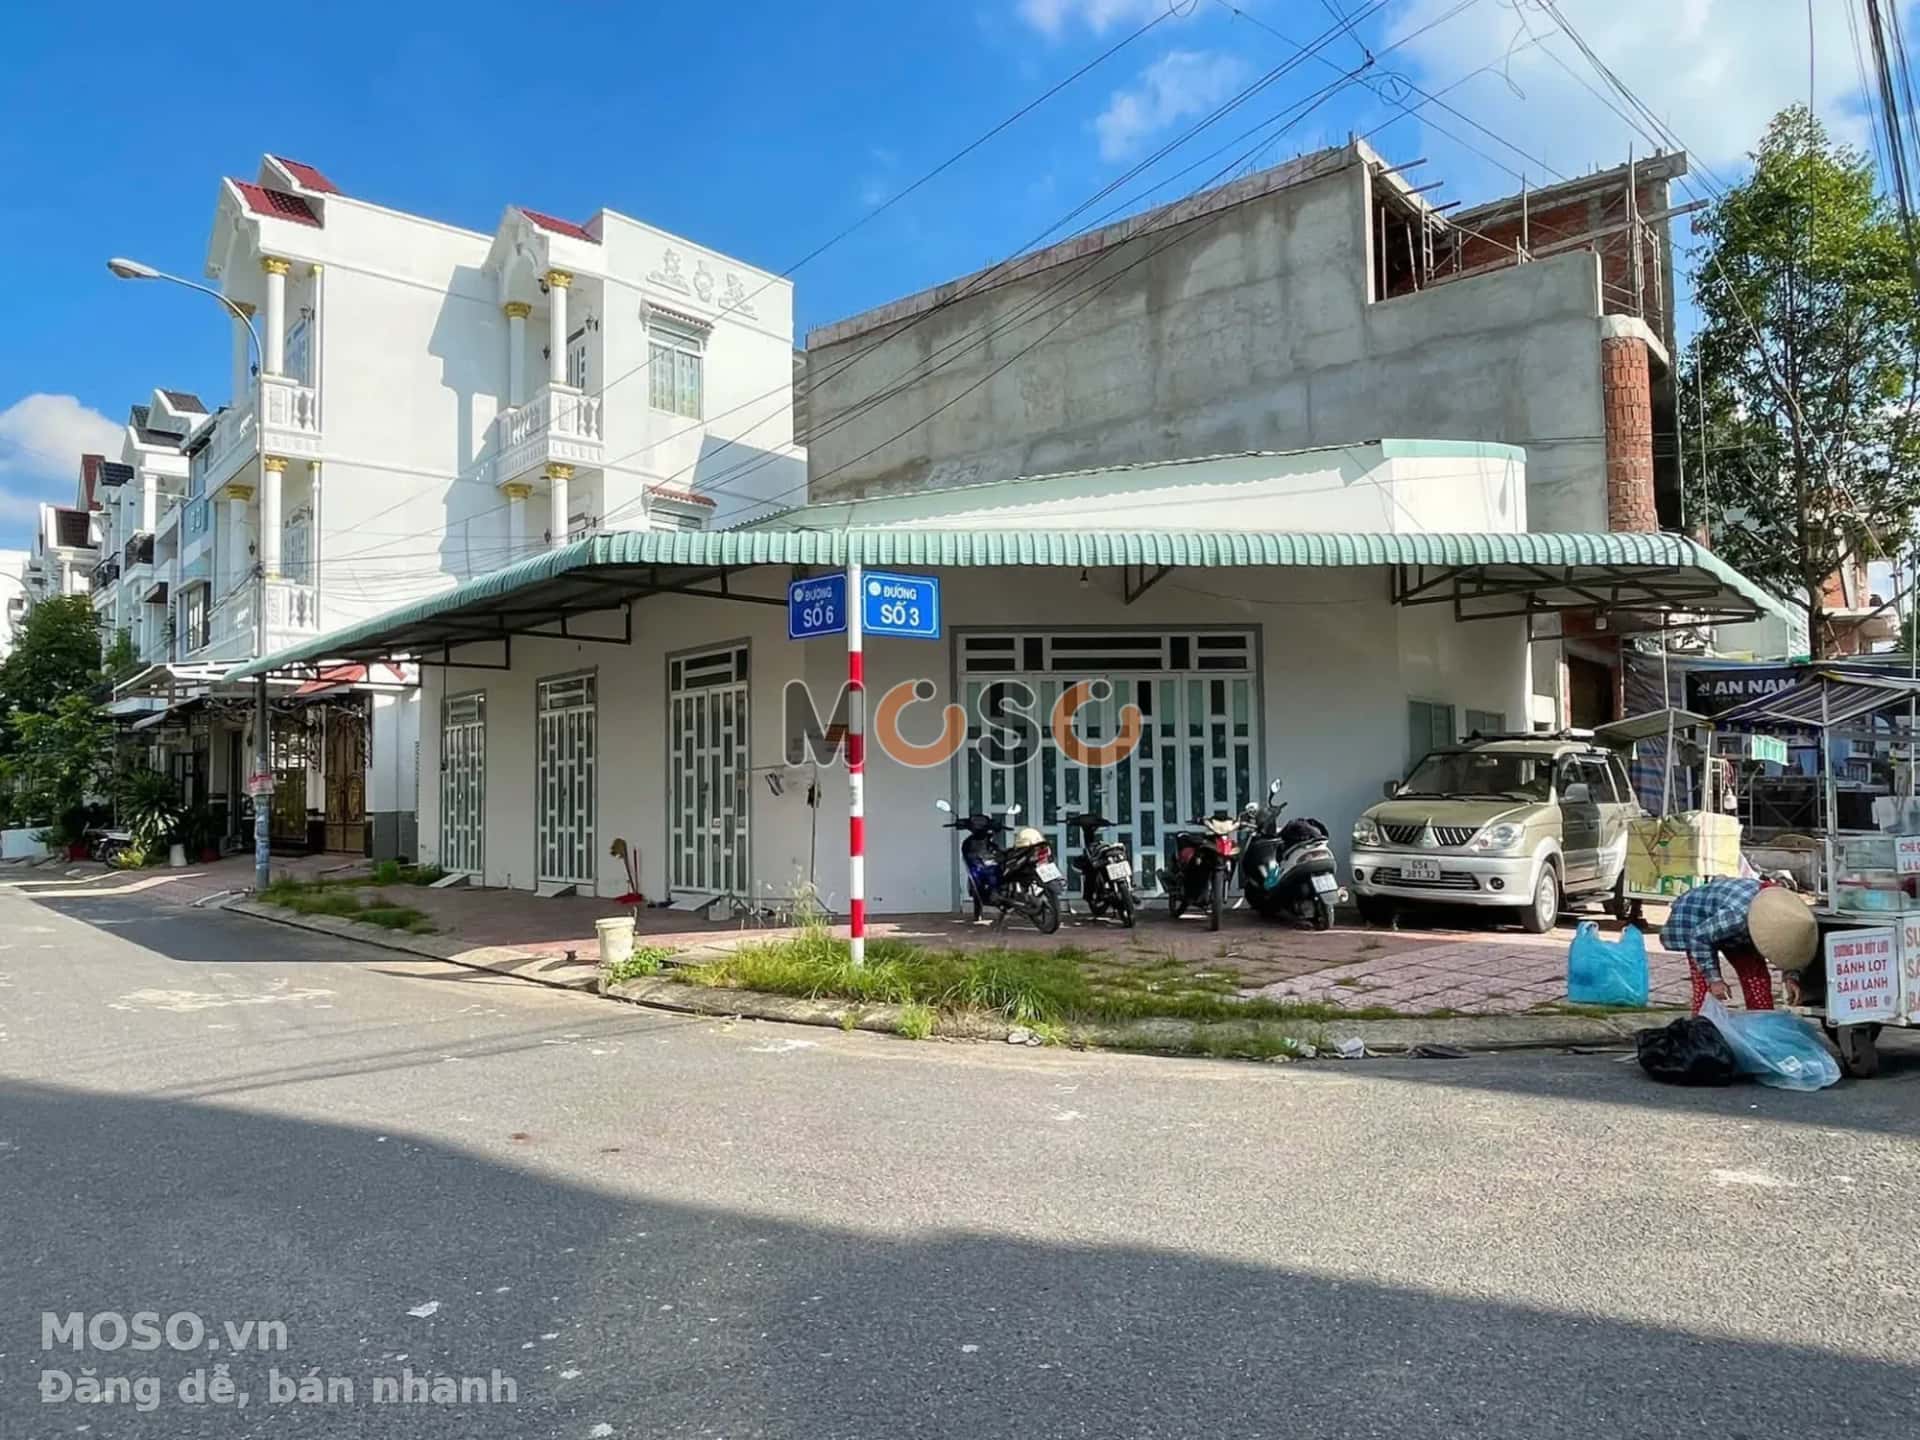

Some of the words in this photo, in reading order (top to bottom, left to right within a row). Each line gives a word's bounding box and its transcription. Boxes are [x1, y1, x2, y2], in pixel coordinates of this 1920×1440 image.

[803, 600, 824, 628] SỐ
[825, 605, 835, 625] 6
[880, 601, 907, 625] SỐ
[909, 607, 920, 627] 3
[1714, 681, 1744, 695] AN
[1748, 678, 1796, 694] NAM
